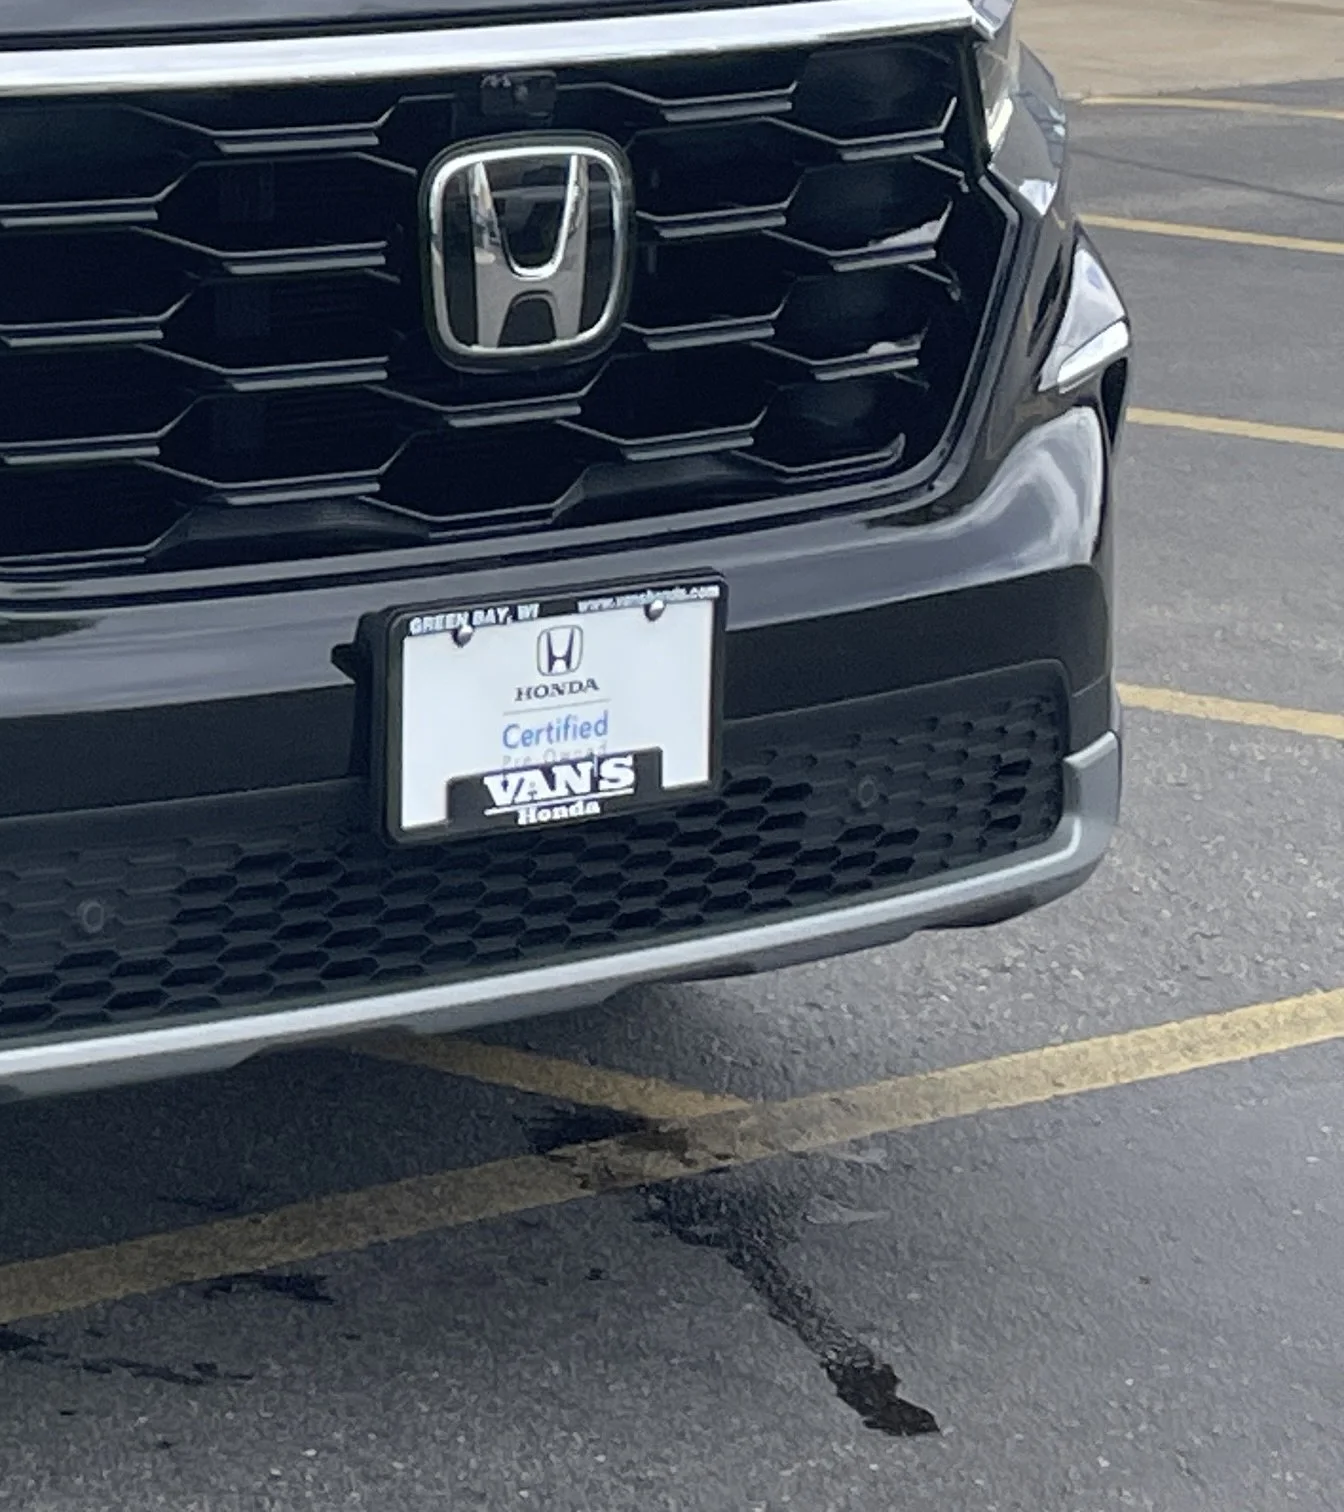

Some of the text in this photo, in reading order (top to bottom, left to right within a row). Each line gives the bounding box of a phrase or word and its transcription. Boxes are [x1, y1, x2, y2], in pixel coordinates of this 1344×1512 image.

[409, 611, 470, 635] GREEN
[517, 603, 540, 620] WI
[514, 677, 600, 701] HONDA
[502, 709, 609, 749] Certified
[517, 799, 601, 826] Honda
